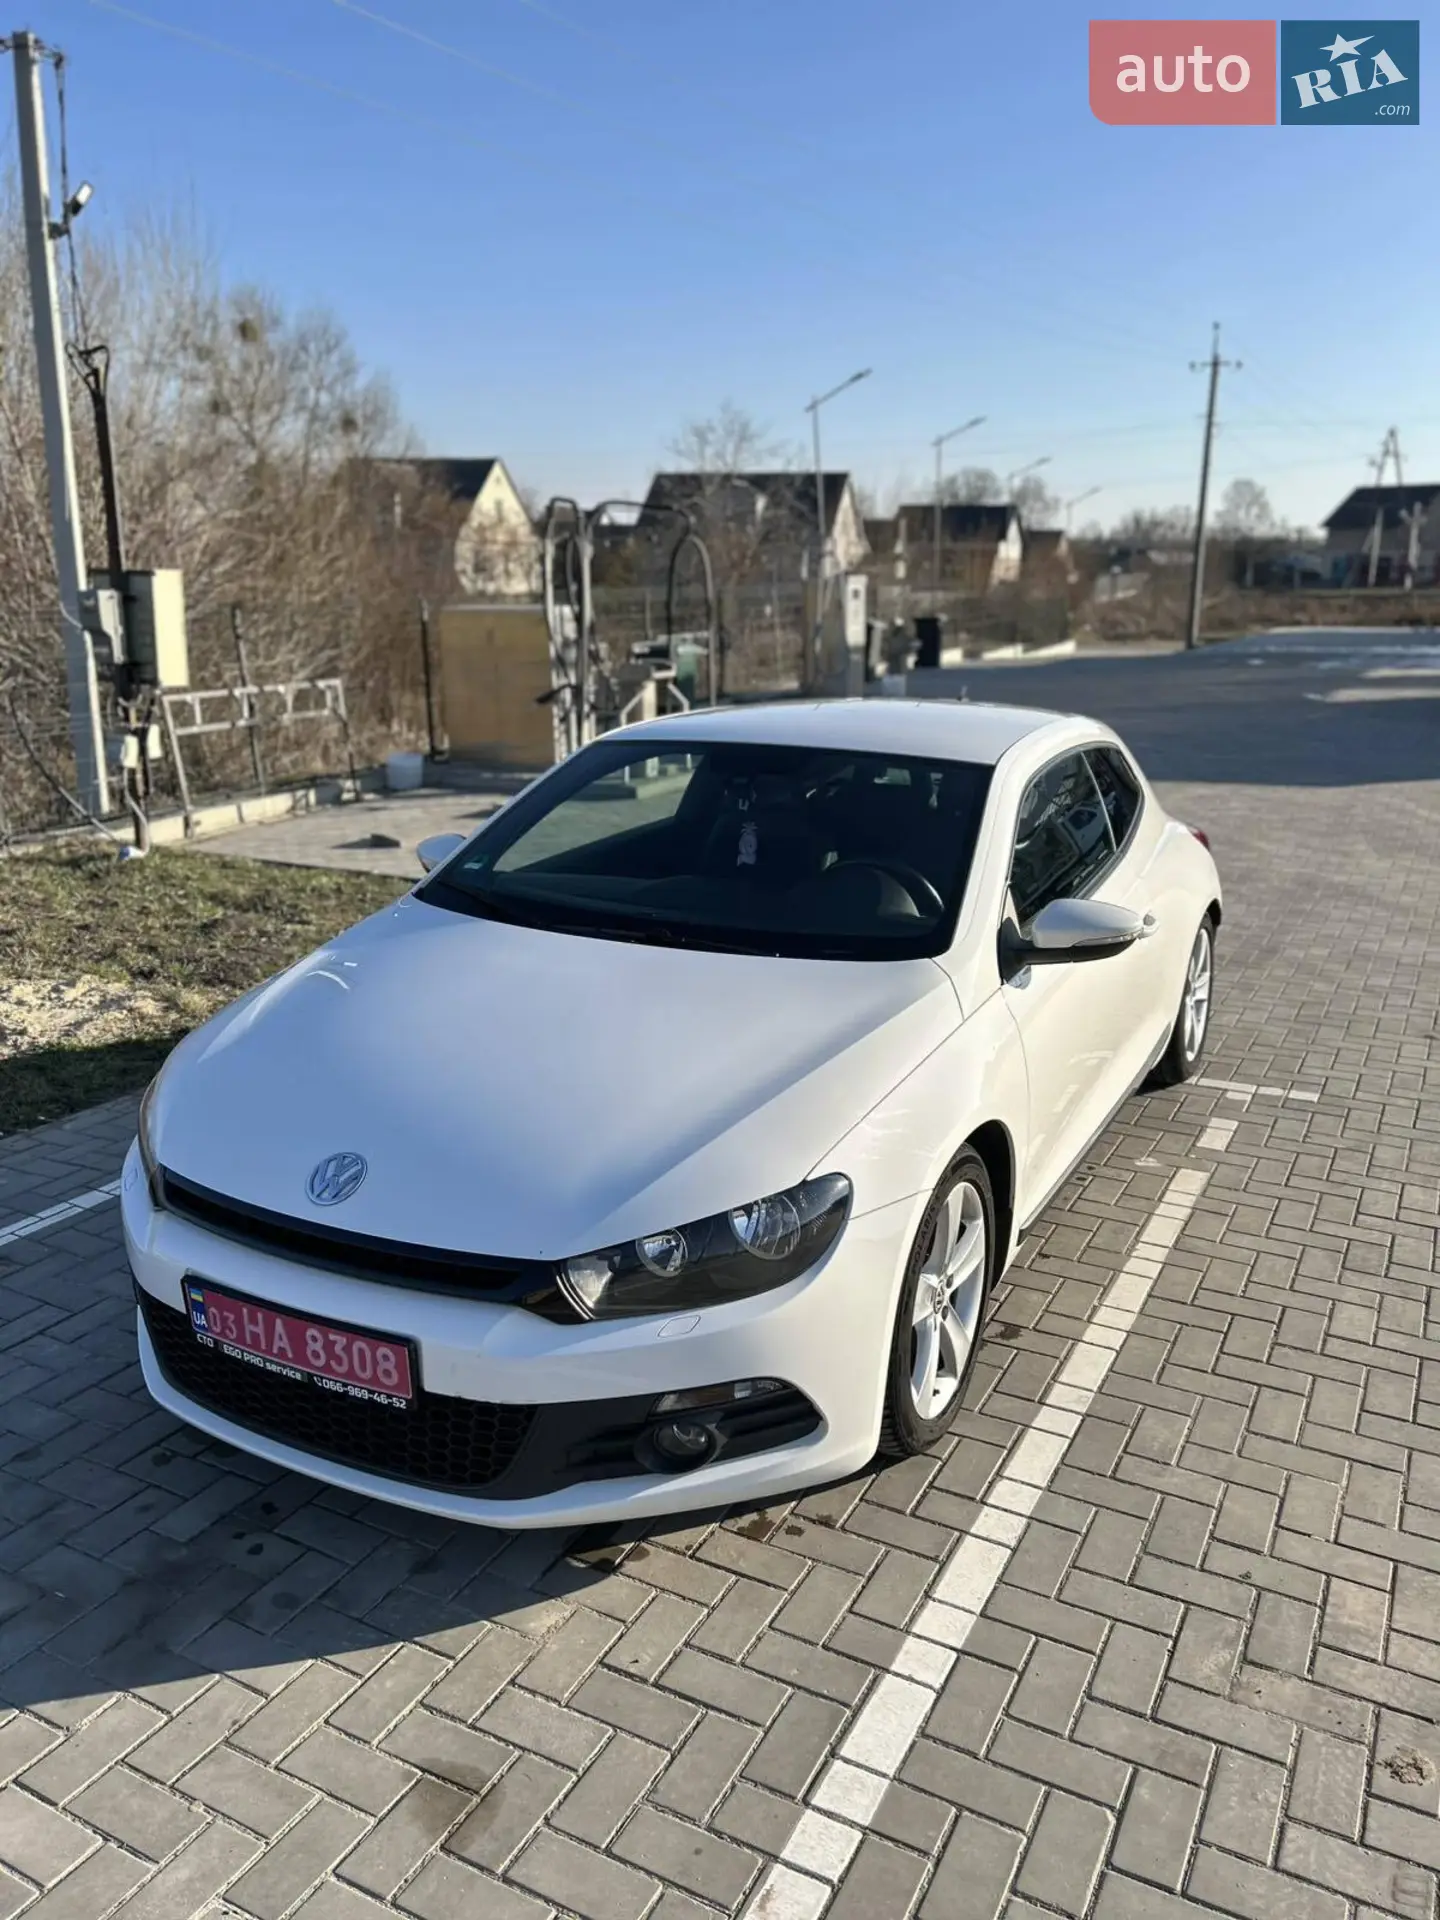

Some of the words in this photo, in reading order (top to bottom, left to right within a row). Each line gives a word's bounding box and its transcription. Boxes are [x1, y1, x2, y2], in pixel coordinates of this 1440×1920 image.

[193, 1310, 208, 1328] UA
[222, 1343, 242, 1361] EGO
[243, 1351, 264, 1368] PRO
[265, 1361, 302, 1381] service
[305, 1327, 399, 1386] 8308
[322, 1378, 407, 1410] 066-969-46-52
